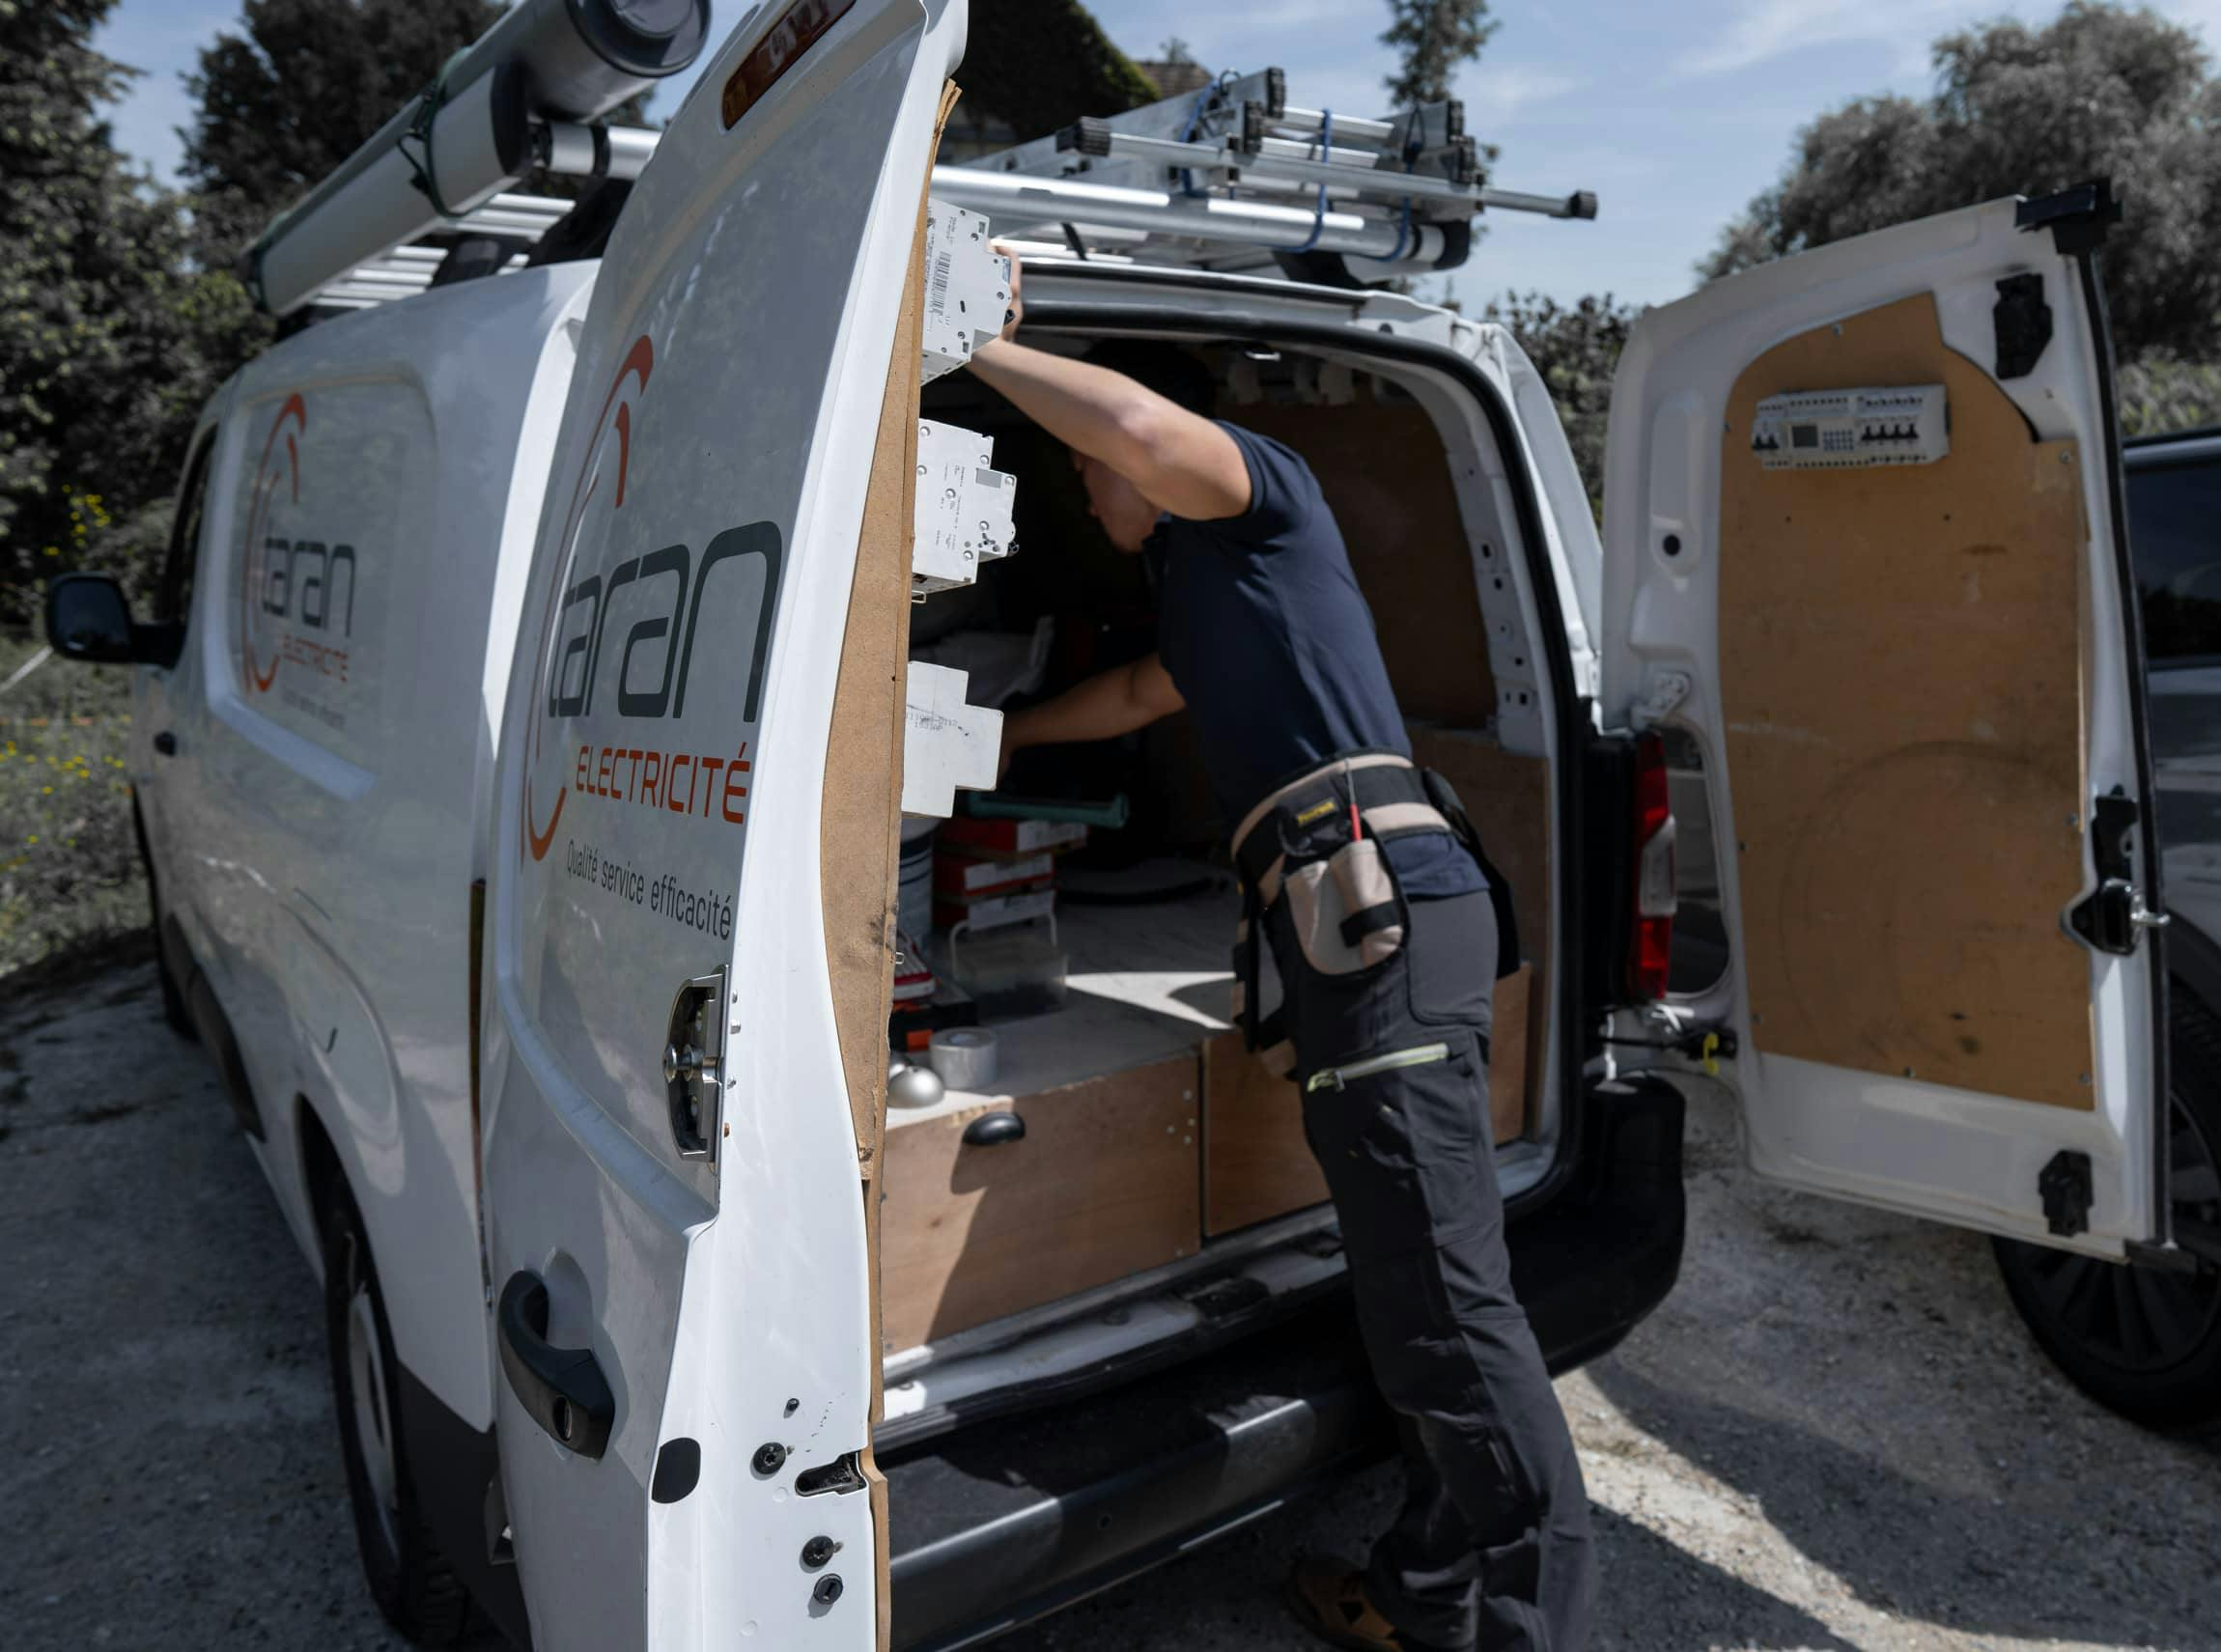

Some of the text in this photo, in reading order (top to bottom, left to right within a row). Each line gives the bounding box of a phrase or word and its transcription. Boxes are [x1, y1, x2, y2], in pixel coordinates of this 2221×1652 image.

[548, 519, 782, 723] taran
[576, 742, 751, 826] ELECTRICITÉ
[567, 839, 732, 941] Qualité service efficacité
